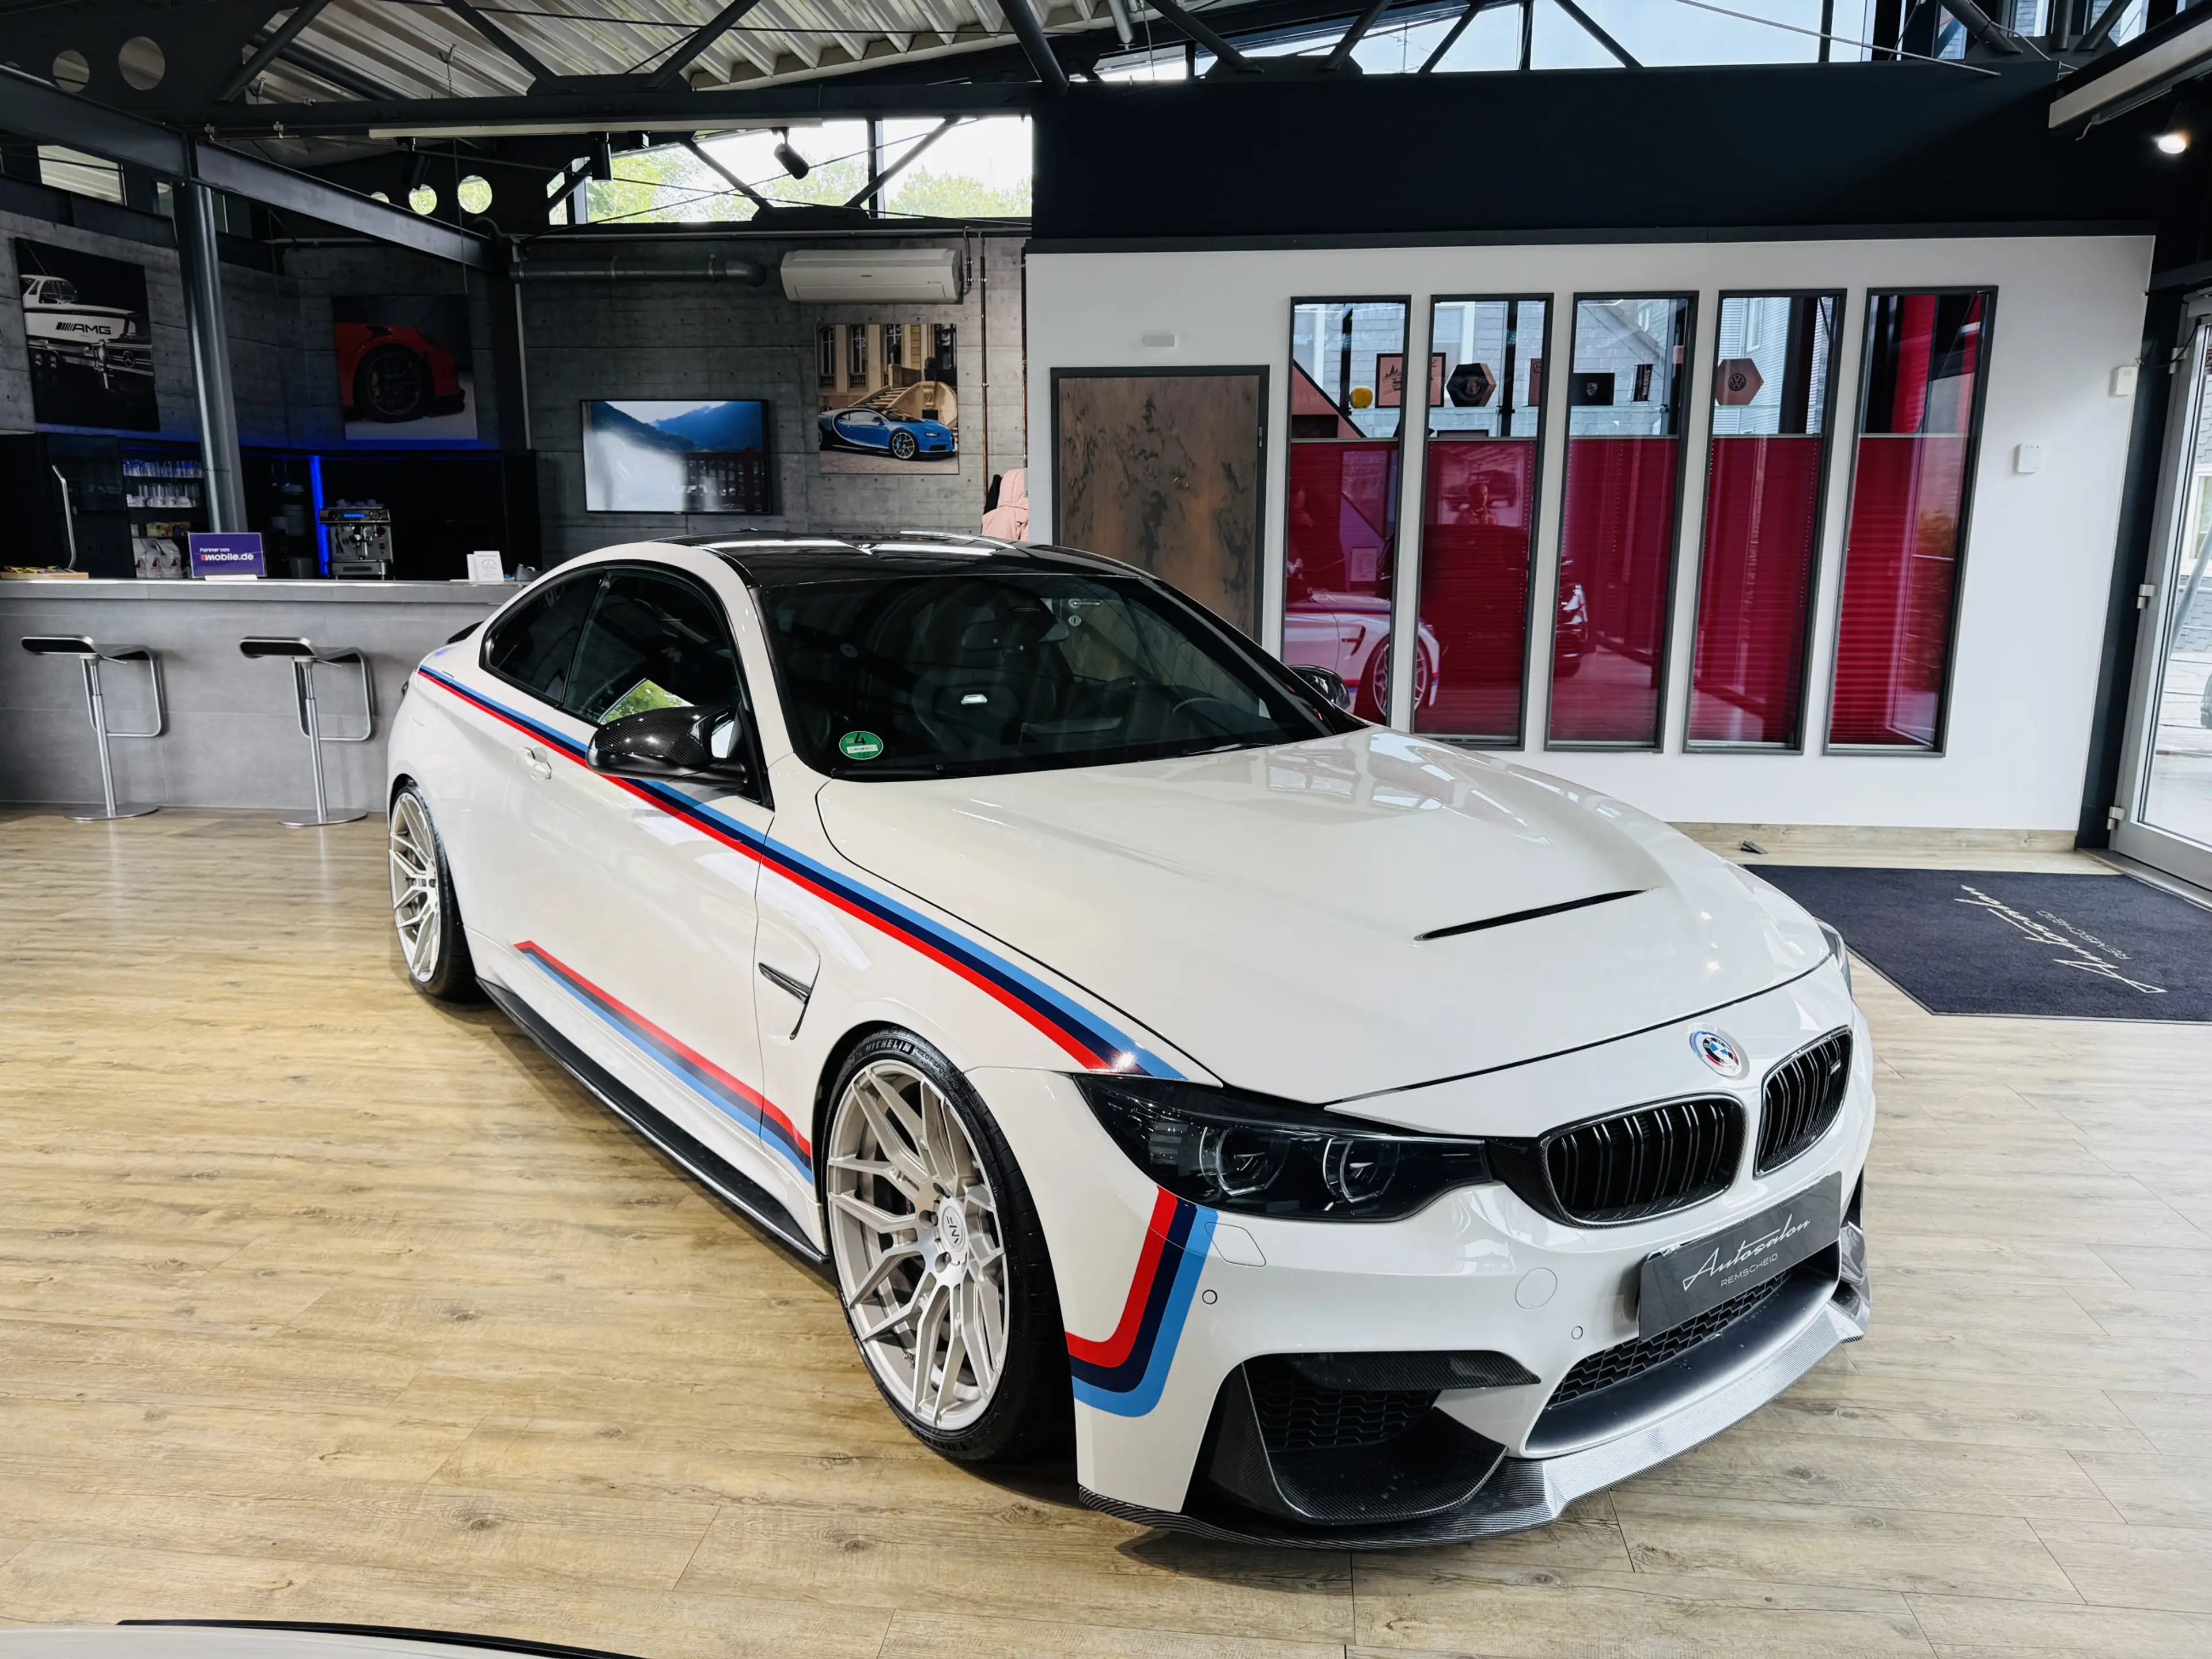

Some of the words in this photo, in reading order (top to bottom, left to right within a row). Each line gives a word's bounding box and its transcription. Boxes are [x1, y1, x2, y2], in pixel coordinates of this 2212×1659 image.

[204, 553, 254, 561] mobile.de
[854, 732, 866, 744] 4
[866, 1039, 912, 1052] MICHELIN
[1683, 1213, 1810, 1291] Autosalon
[1721, 1253, 1779, 1288] REMSCHEID
